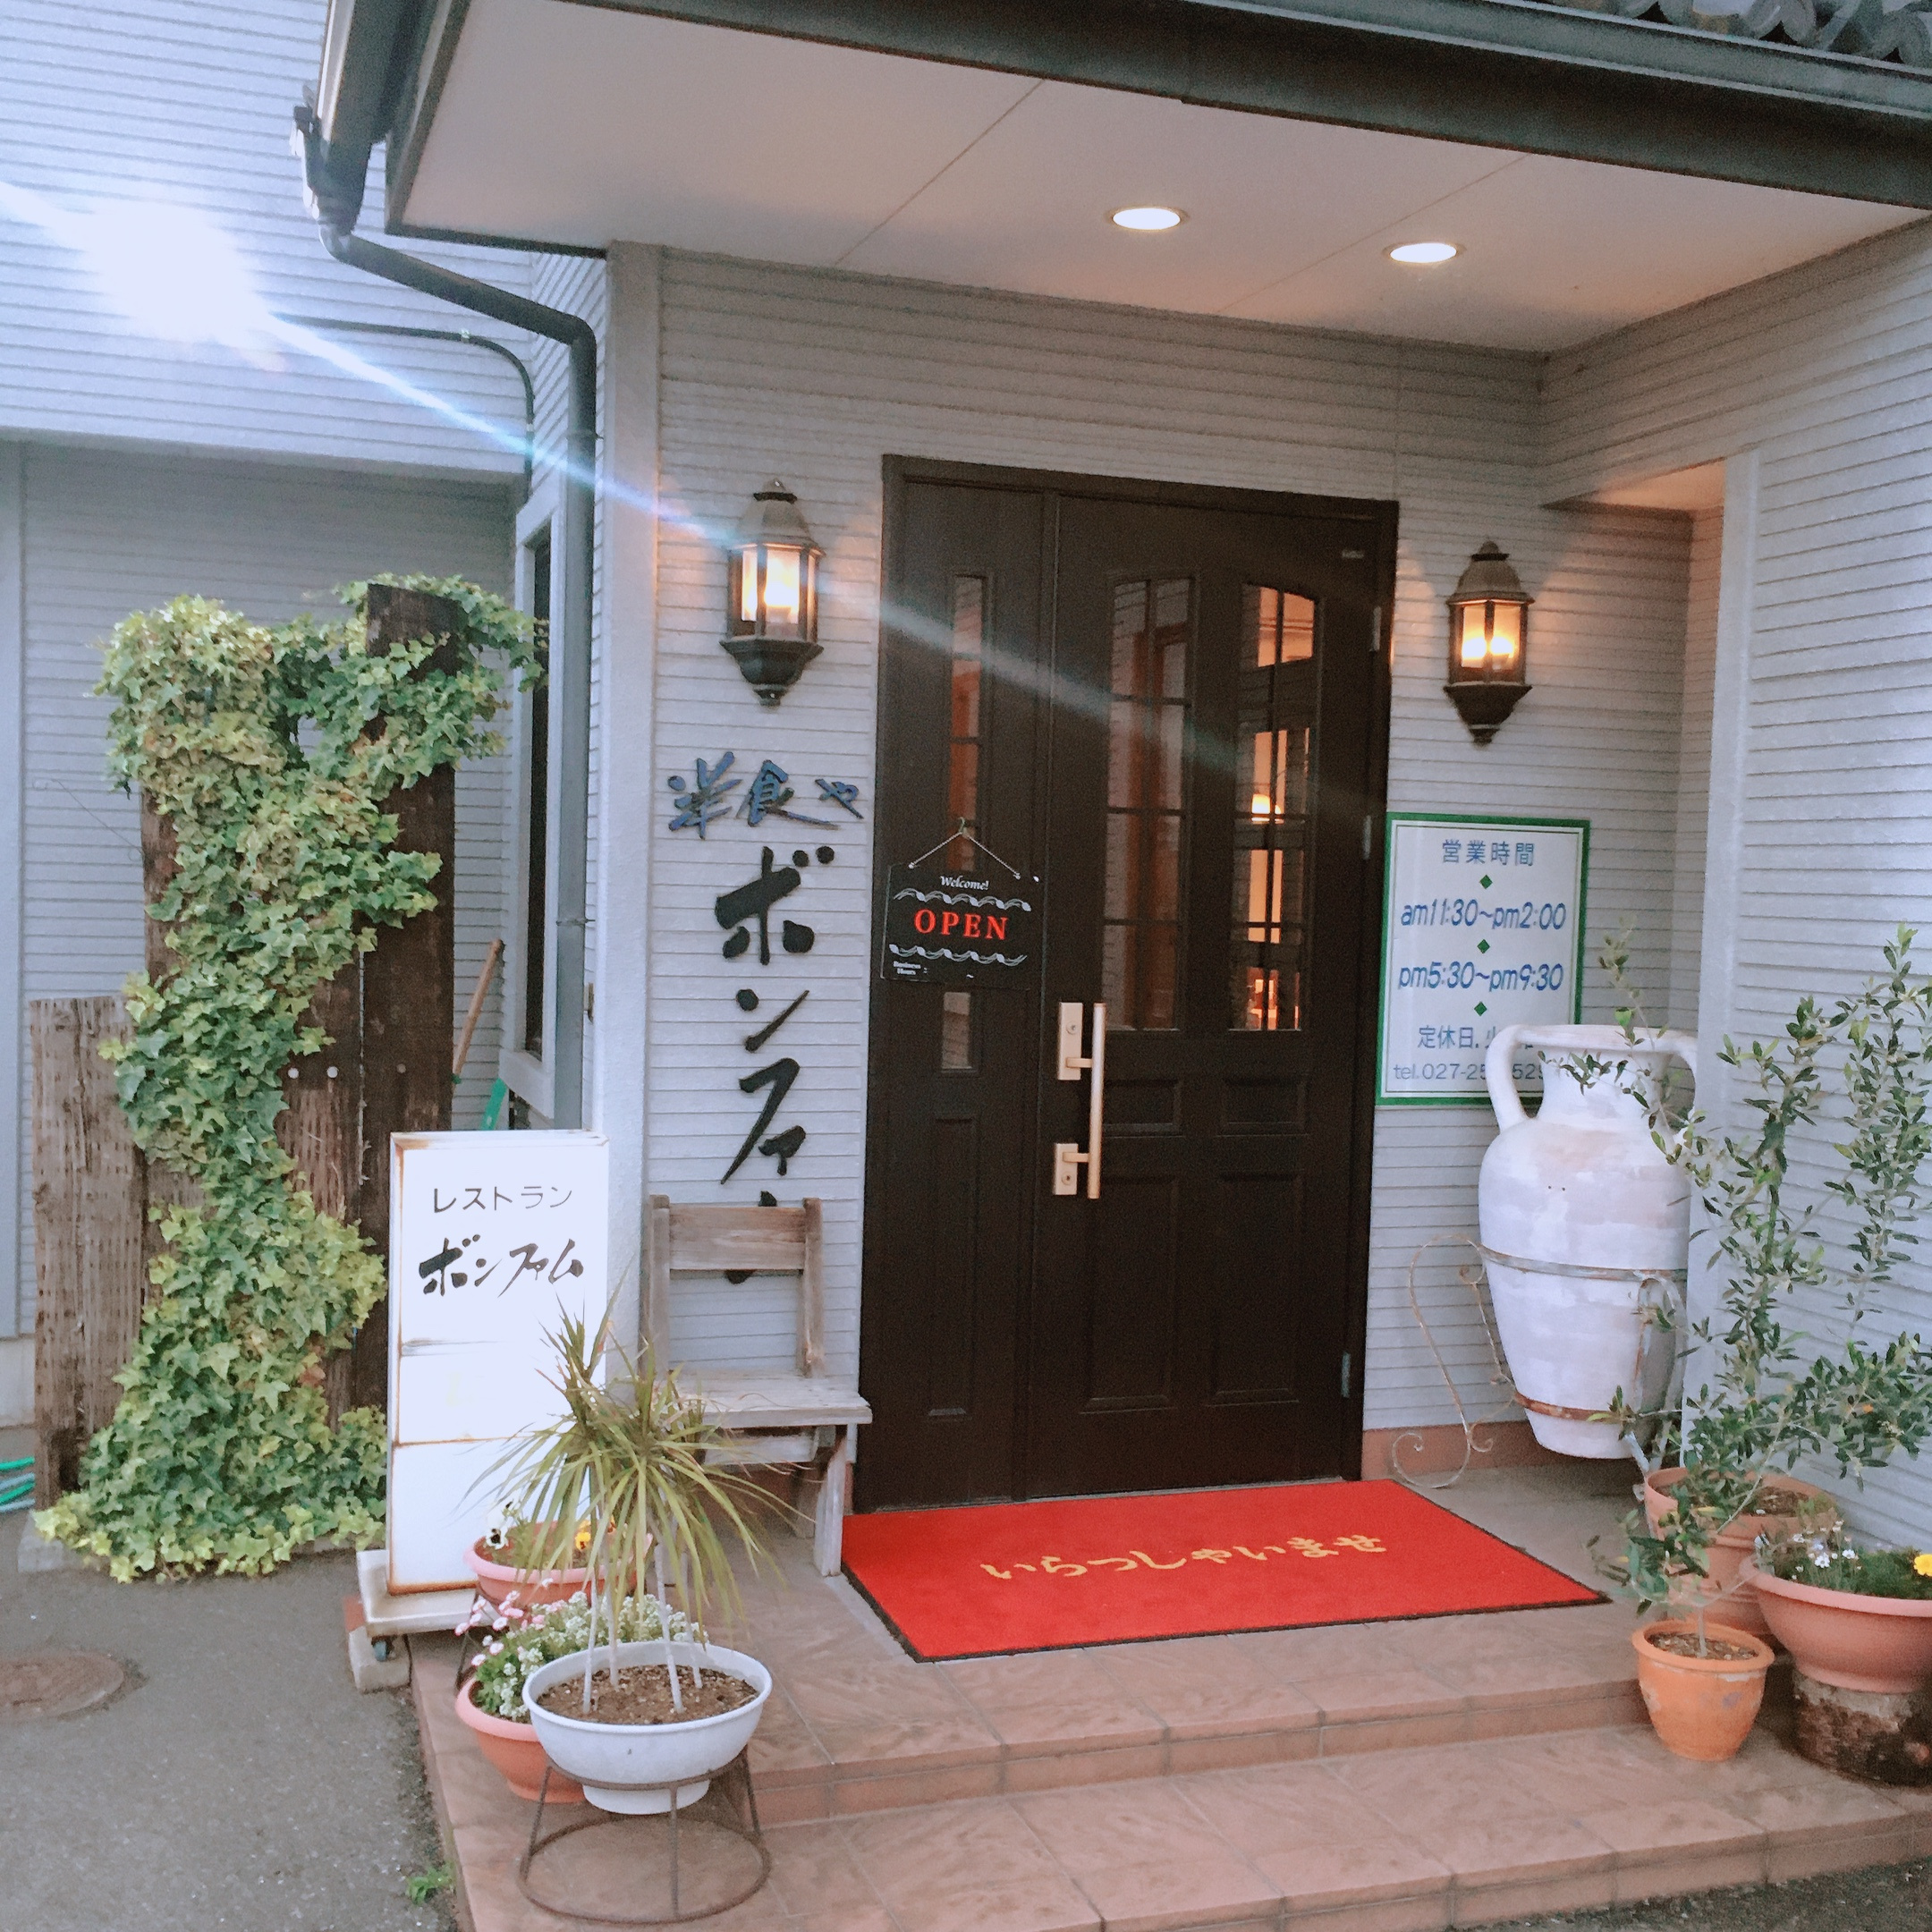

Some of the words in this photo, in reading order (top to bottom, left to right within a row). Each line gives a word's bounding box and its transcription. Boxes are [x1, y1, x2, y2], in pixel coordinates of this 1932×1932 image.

[667, 750, 864, 840] 洋食や
[1442, 839, 1535, 866] 営業時間
[940, 875, 989, 891] Welcome!
[913, 908, 1008, 940] OPEN
[715, 845, 835, 1284] ボンファ
[433, 1185, 573, 1214] レストラン
[419, 1233, 585, 1299] ボンファム
